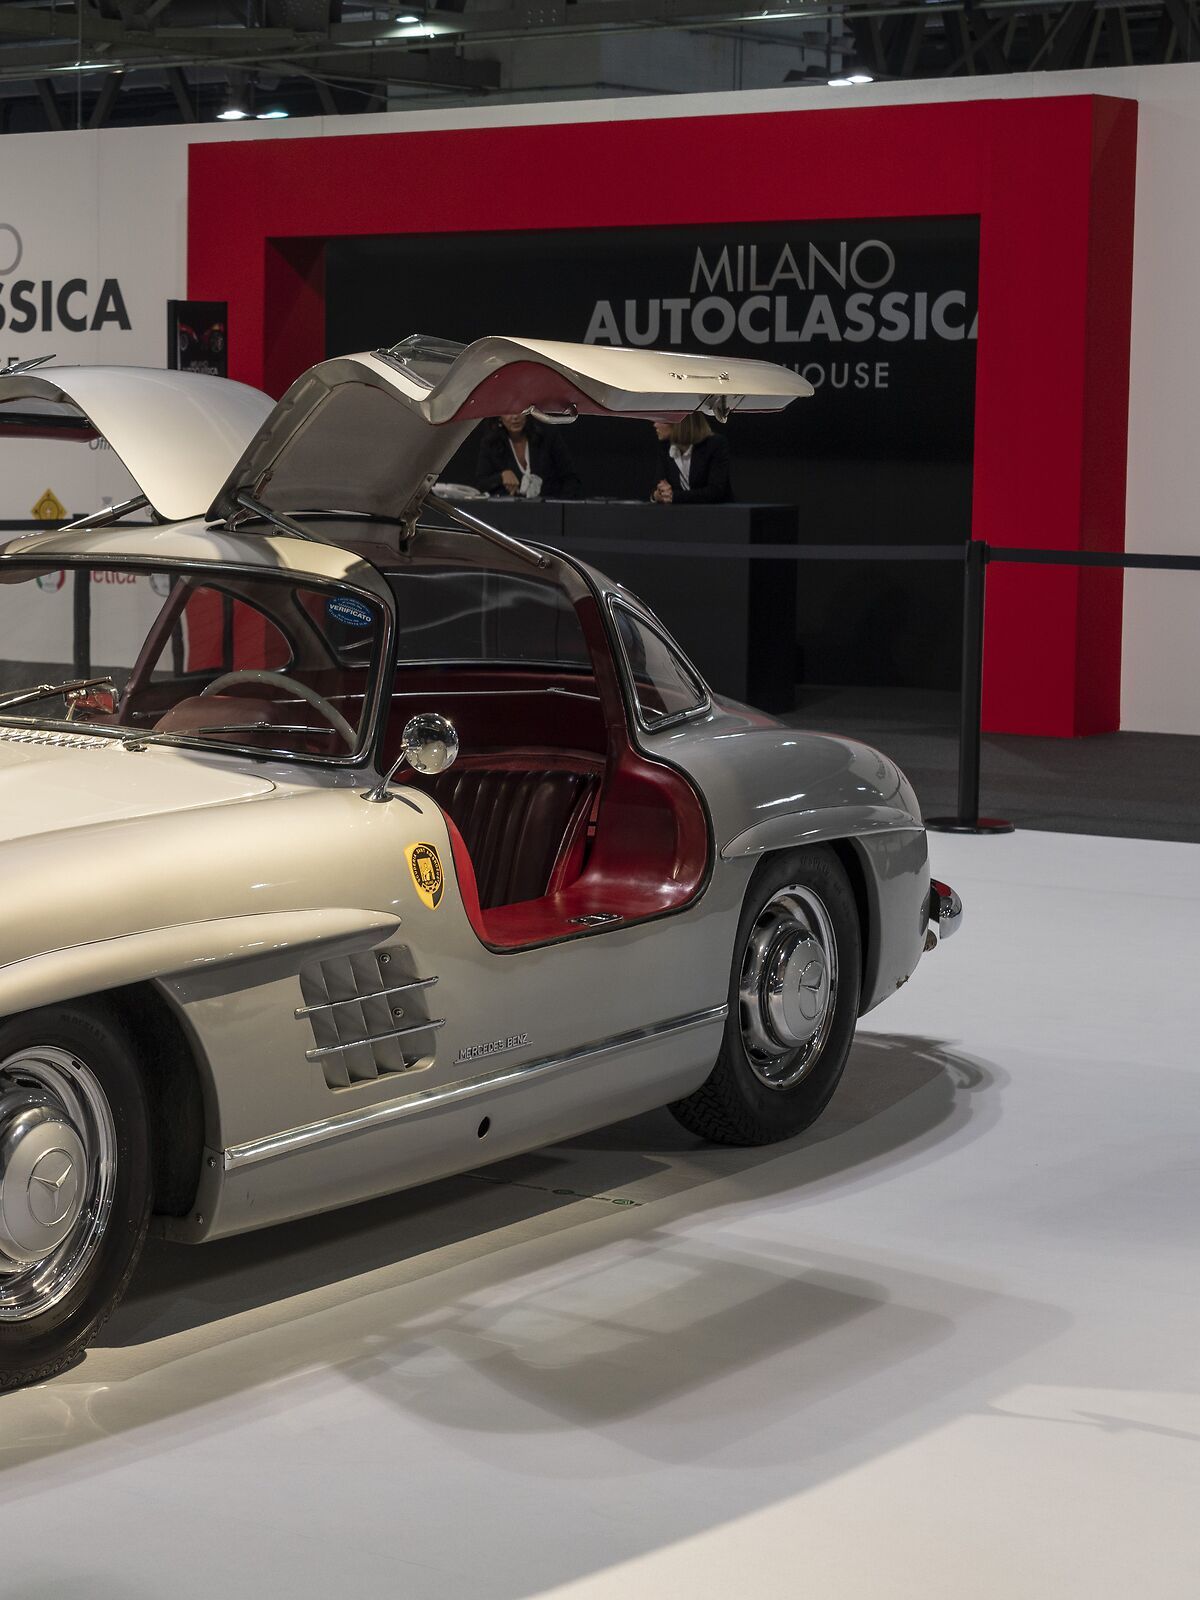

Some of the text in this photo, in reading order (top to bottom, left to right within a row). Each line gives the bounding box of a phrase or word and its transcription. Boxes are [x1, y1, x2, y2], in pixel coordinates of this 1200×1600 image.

[690, 239, 896, 293] MILANO
[583, 290, 979, 346] AUTOCLASSIC
[782, 362, 889, 388] OUSE
[329, 603, 372, 622] VERIFICATO
[458, 1033, 529, 1061] MERCEDES BENZ
